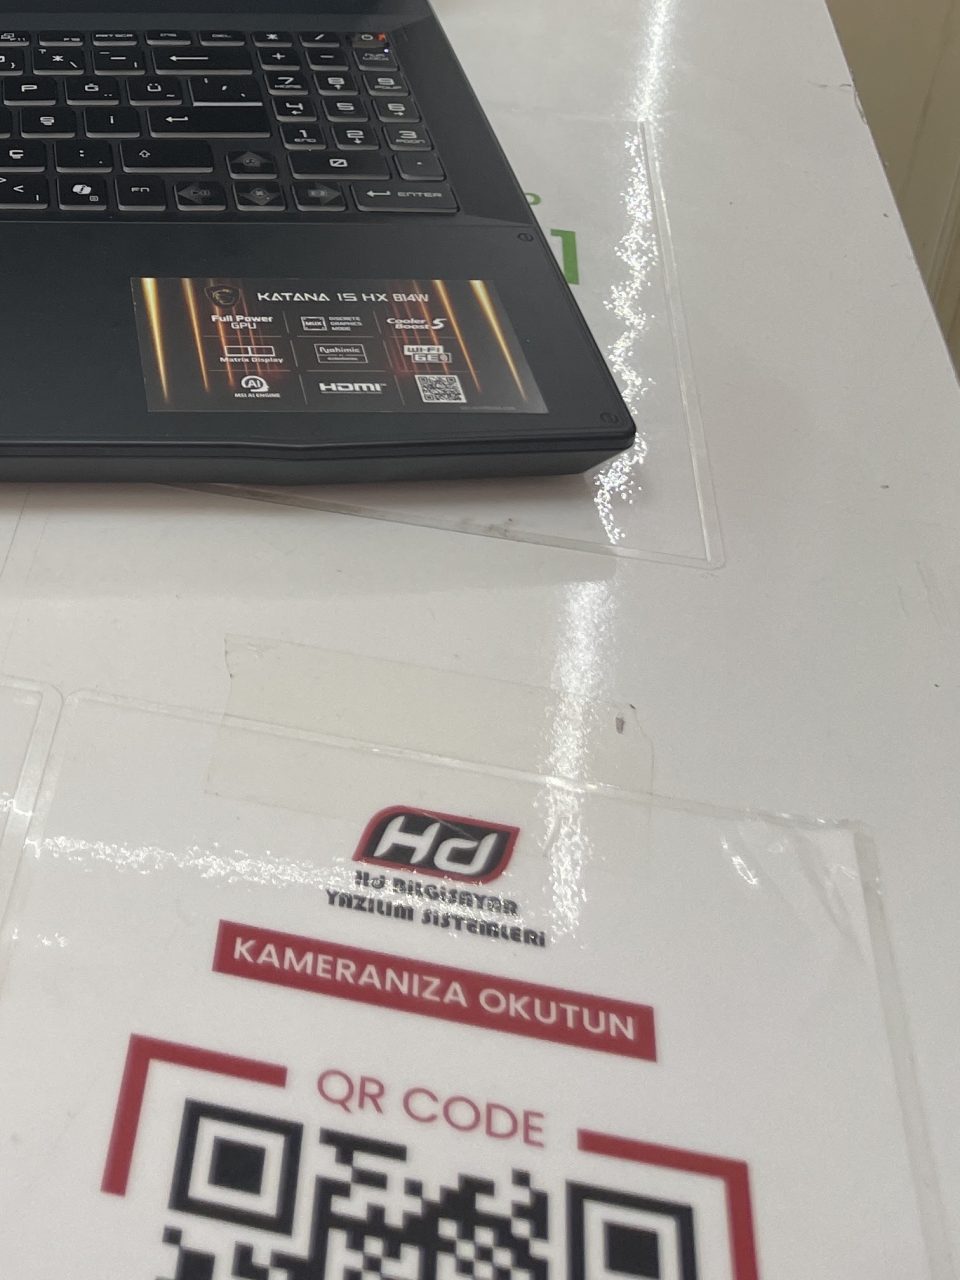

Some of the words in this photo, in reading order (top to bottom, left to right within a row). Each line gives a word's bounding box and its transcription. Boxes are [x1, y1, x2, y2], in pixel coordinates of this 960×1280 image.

[147, 84, 161, 92] Ü
[346, 130, 364, 138] 2
[399, 130, 417, 138] 3
[329, 159, 348, 167] 0
[257, 293, 330, 302] KATANA
[362, 293, 389, 302] HX
[236, 315, 273, 323] Power
[319, 383, 381, 391] HDMI
[373, 815, 499, 876] Hd
[326, 888, 414, 922] YAZILIM
[234, 937, 468, 1009] KAMERANIZA
[478, 987, 635, 1041] OKUTUN
[317, 1069, 385, 1114] QR
[402, 1086, 545, 1148] CODE
